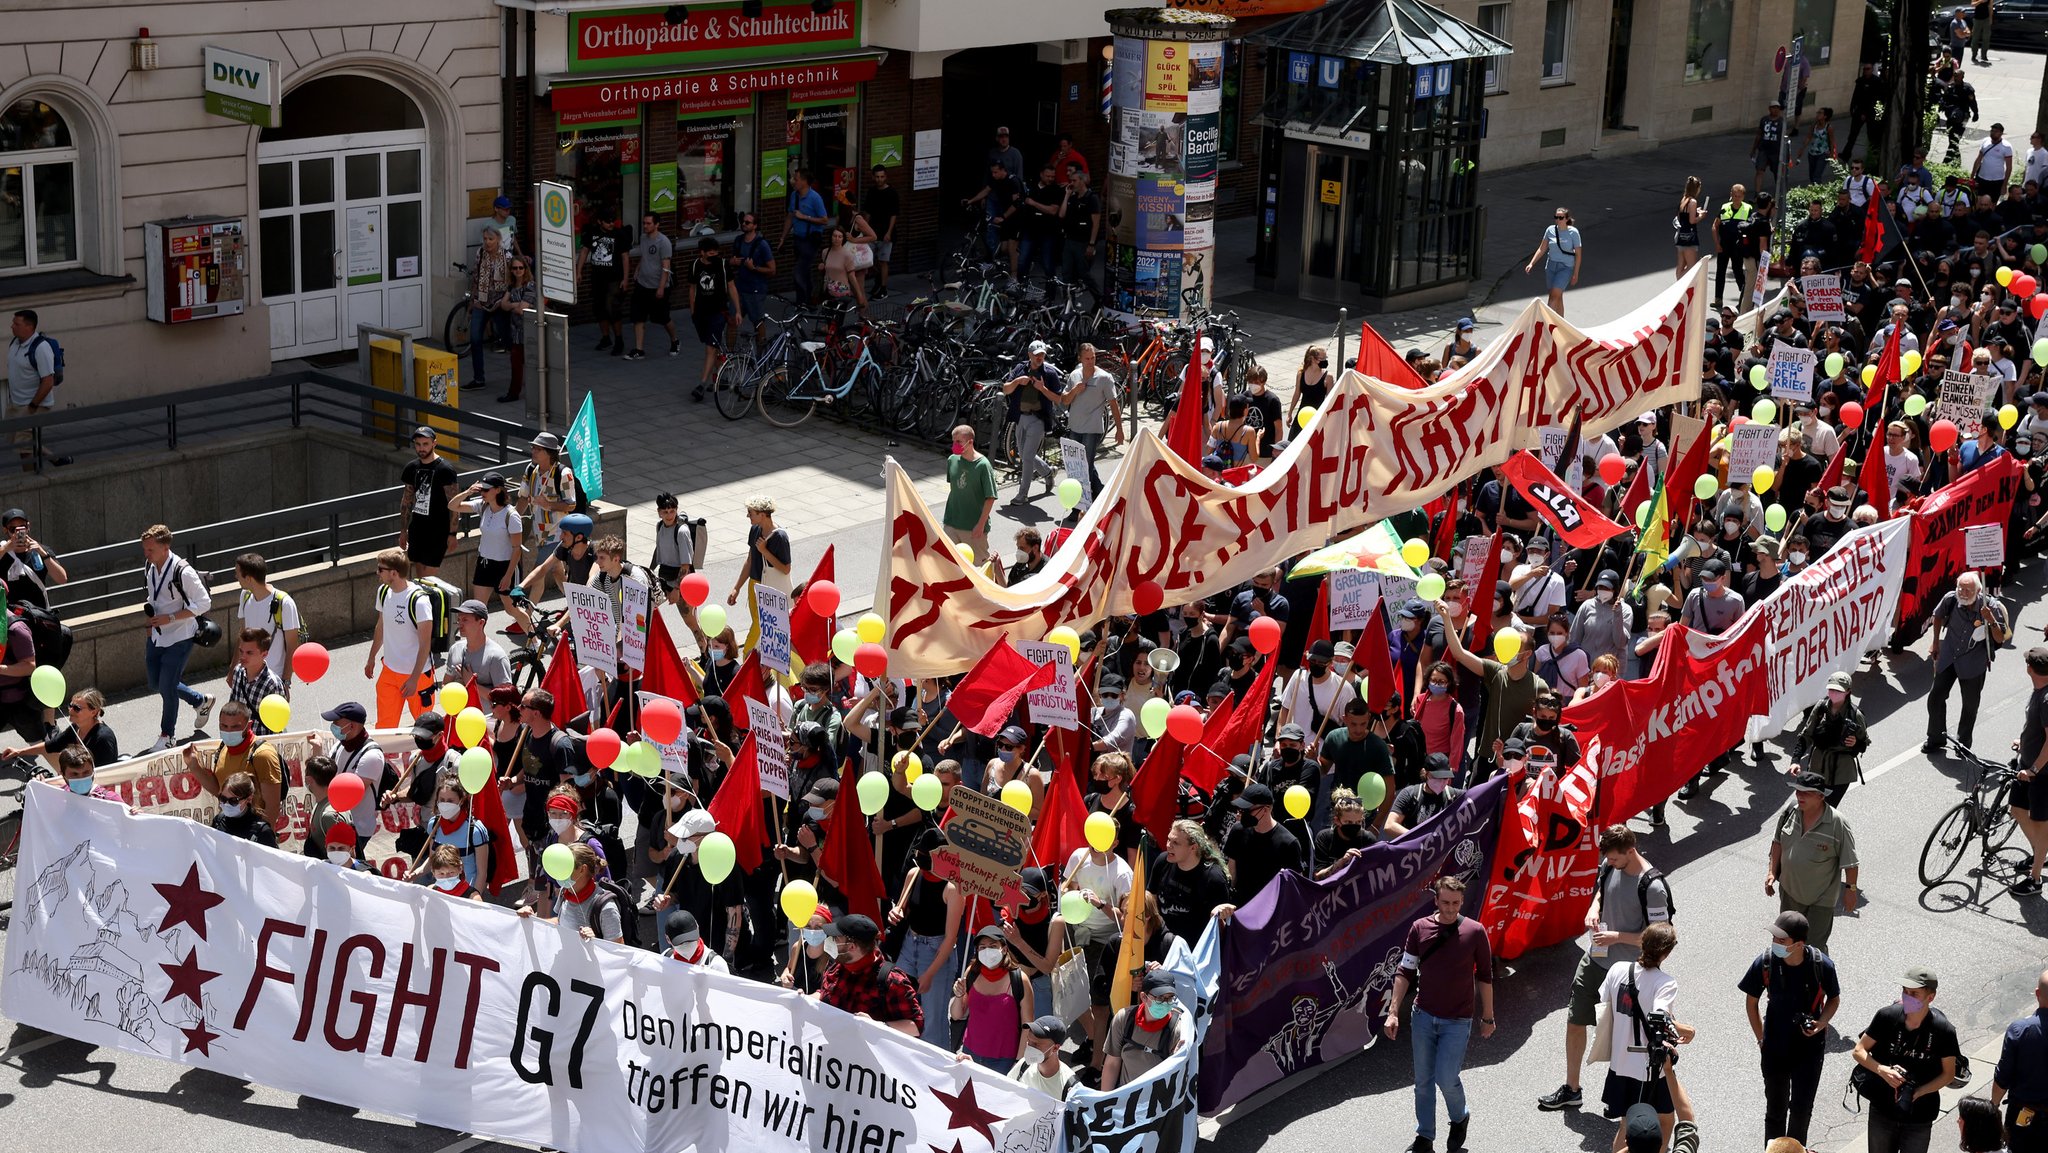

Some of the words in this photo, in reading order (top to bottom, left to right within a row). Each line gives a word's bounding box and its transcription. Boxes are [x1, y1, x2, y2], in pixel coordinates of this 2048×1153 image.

[584, 21, 699, 51] Orthopädie
[704, 16, 723, 41] &
[727, 8, 849, 40] Schuhtechnik
[1156, 62, 1181, 71] GLÜCK
[1324, 60, 1340, 84] U
[213, 62, 260, 90] DKV
[600, 81, 700, 103] Orthopädie
[709, 77, 719, 91] &
[729, 67, 840, 90] Schuhtechnik
[1437, 68, 1449, 92] U
[1158, 83, 1177, 91] SPÜL
[1187, 127, 1218, 142] Cecilia
[1187, 140, 1217, 155] Bartoli
[1137, 203, 1175, 213] KISSIN
[1137, 257, 1156, 267] 2022
[1806, 278, 1826, 288] FIGHT
[1828, 278, 1836, 286] G7
[1806, 288, 1842, 298] SCHLUSS
[1776, 361, 1803, 373] KRIEG
[1778, 352, 1799, 362] FIGHT
[1802, 354, 1812, 364] G7
[1775, 369, 1798, 380] DEM
[1945, 371, 1971, 384] BULLEN
[1773, 377, 1806, 391] KRIEG
[1943, 382, 1975, 396] BONZEN
[1942, 392, 1974, 406] BANKEN
[1737, 429, 1762, 439] FIGHT
[1763, 429, 1775, 439] G7
[1335, 571, 1380, 592] GRENZEN
[571, 591, 596, 608] FIGHT
[598, 596, 608, 611] G7
[625, 586, 640, 603] FIGHT
[758, 591, 777, 608] FIGHT
[778, 596, 786, 612] G7
[1341, 589, 1363, 606] AUF
[577, 607, 610, 626] POWER
[1332, 603, 1361, 617] REFUGEES
[587, 620, 599, 631] TO
[586, 629, 605, 642] THE
[1794, 618, 1831, 687] DER
[1831, 585, 1885, 659] NATO
[1026, 649, 1054, 664] FIGHT
[1057, 650, 1068, 665] G7
[1028, 693, 1077, 713] AUFRÜSTUNG
[752, 707, 768, 726] FIGHT
[752, 724, 772, 743] KRIEG
[759, 758, 788, 783] TOPPEN
[953, 788, 983, 806] STOPPT
[983, 799, 996, 811] DIE
[997, 804, 1026, 824] KRIEGE
[949, 797, 964, 811] DER
[965, 805, 1027, 836] HERRSCHENDEN!
[937, 848, 998, 883] Klassenkampf
[948, 870, 1004, 903] Burgfrieden!
[1367, 862, 1398, 897] IM
[233, 917, 501, 1071] FIGHT
[509, 970, 606, 1091] G7
[623, 999, 672, 1051] Den
[681, 1011, 918, 1111] Imperialismus
[627, 1061, 753, 1116] treffen
[763, 1087, 815, 1143] wir
[825, 1103, 904, 1153] hier
